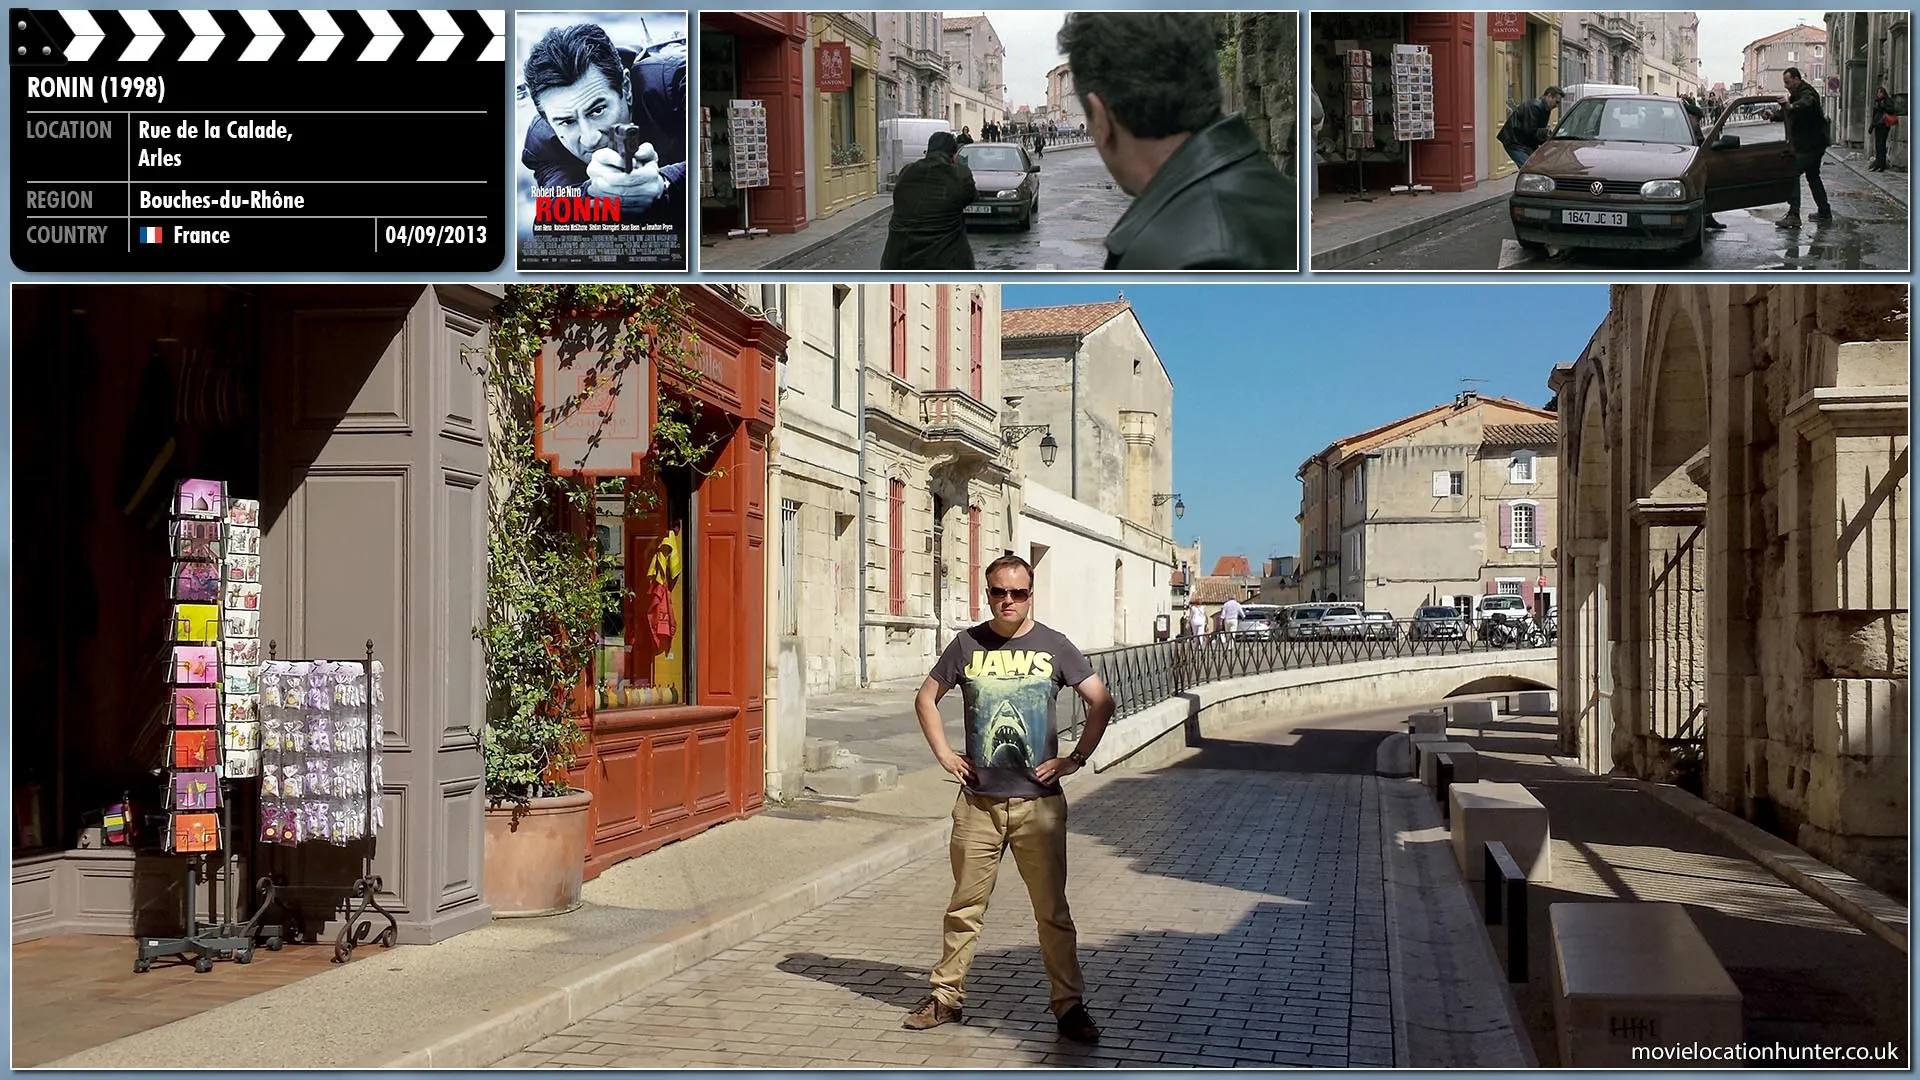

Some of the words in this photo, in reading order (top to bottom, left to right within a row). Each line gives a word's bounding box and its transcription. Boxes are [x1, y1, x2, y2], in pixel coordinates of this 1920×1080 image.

[531, 186, 555, 198] Robert
[536, 196, 621, 222] RONIN
[1568, 211, 1590, 223] 1647
[1594, 213, 1607, 224] JC
[1612, 214, 1623, 225] 13
[963, 650, 1054, 679] JAWS
